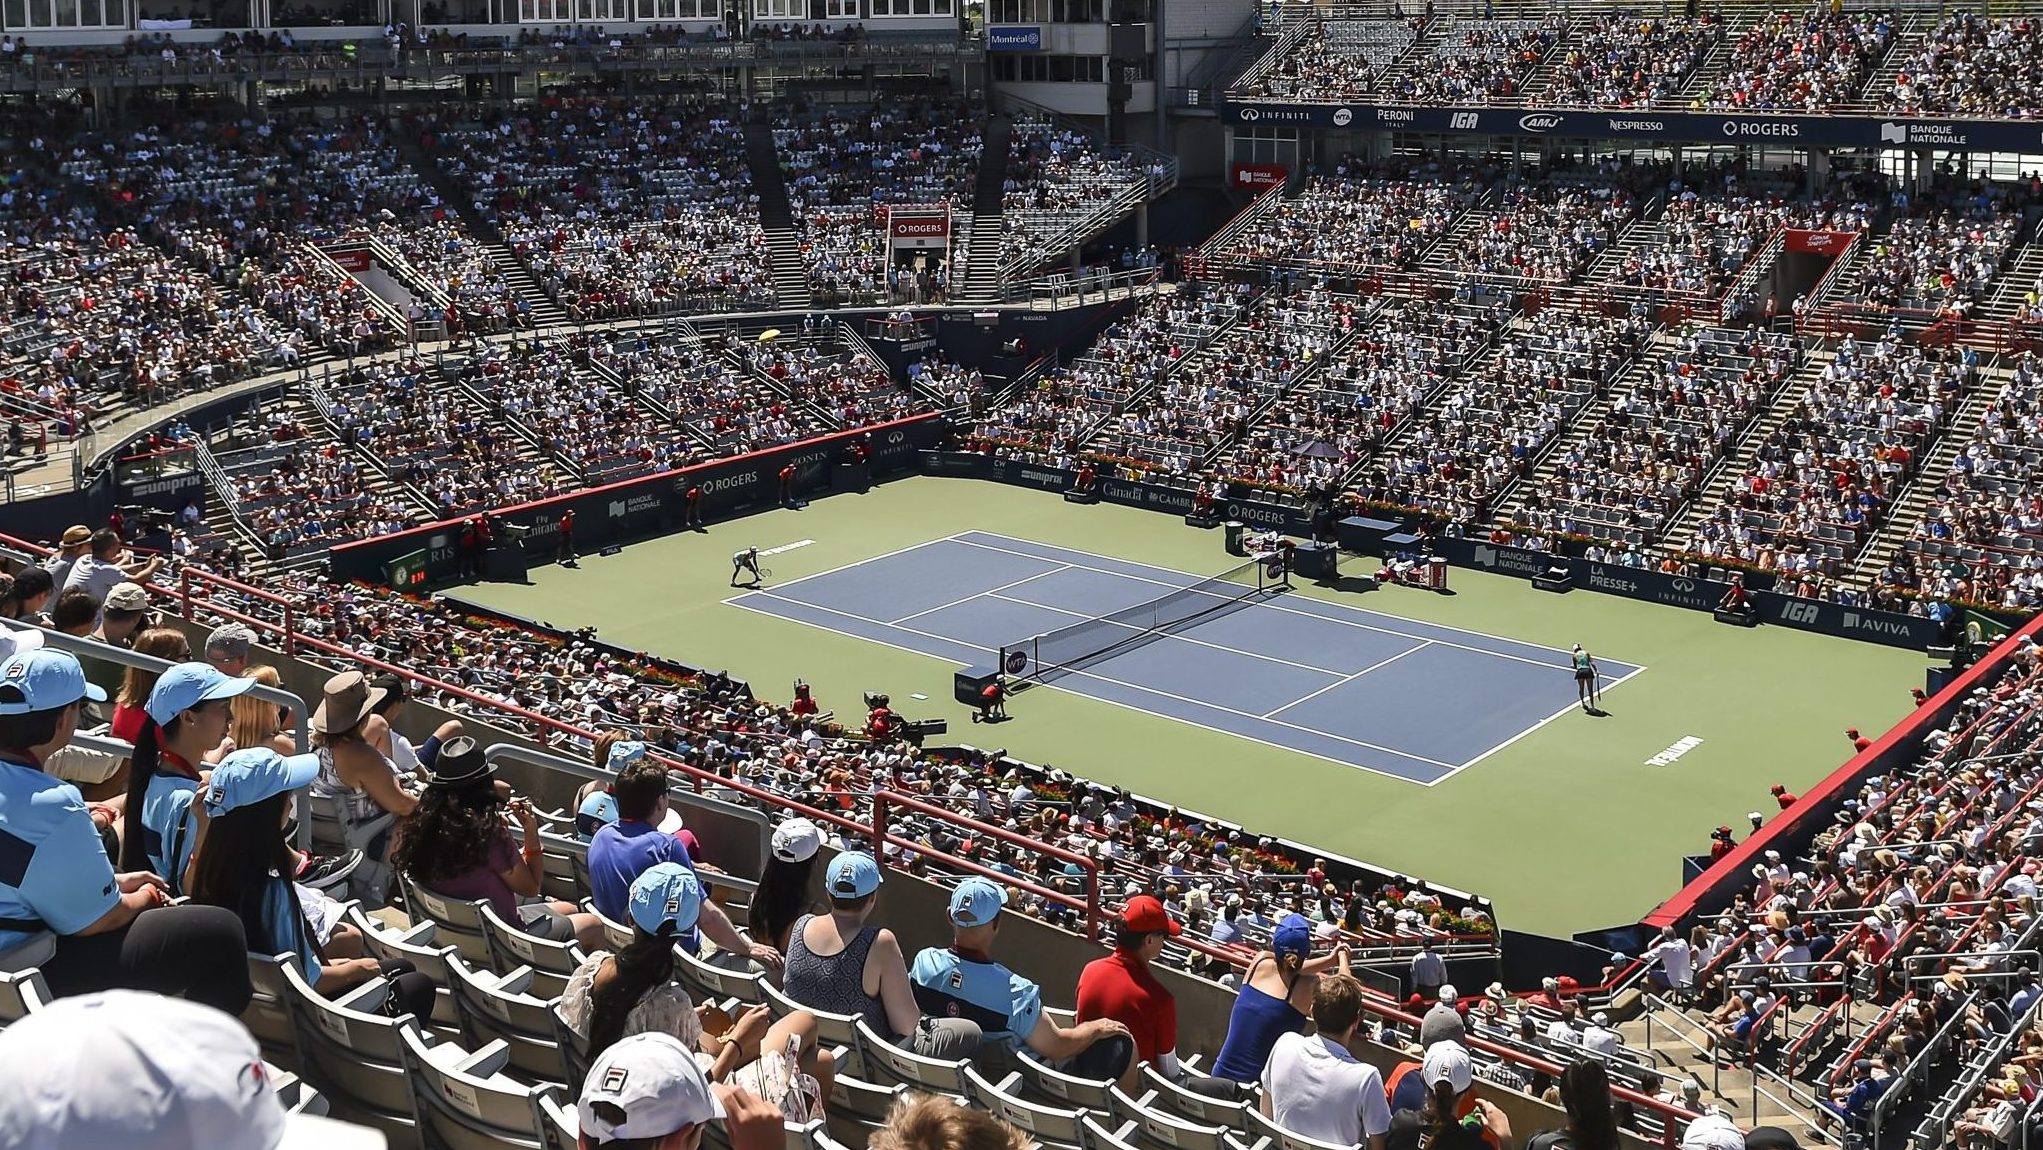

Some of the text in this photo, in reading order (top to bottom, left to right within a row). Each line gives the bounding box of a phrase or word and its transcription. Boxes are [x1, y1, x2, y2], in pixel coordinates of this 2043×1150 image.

[991, 34, 1028, 44] Montréal
[1262, 111, 1309, 120] INFINITI
[1377, 109, 1414, 121] PERONI
[1450, 112, 1479, 129] IGA
[1526, 117, 1559, 128] AMJ
[1609, 118, 1664, 131] NESPRESSO
[1910, 124, 1953, 134] BANQUE
[1740, 123, 1799, 136] ROGERS
[1910, 135, 1967, 145] NATIONALE
[908, 224, 942, 233] ROGERS
[148, 474, 201, 495] uniprix
[715, 471, 758, 491] ROGERS
[1030, 472, 1063, 486] uniprix
[1102, 482, 1142, 501] Canada
[1241, 506, 1286, 525] ROGERS
[1499, 550, 1533, 563] BANQUE
[1498, 559, 1544, 574] NATIONALE
[1590, 564, 1604, 576] LA
[1658, 592, 1706, 606] INFINITI
[1780, 600, 1820, 625] IGA
[1862, 618, 1911, 637] AVIVA
